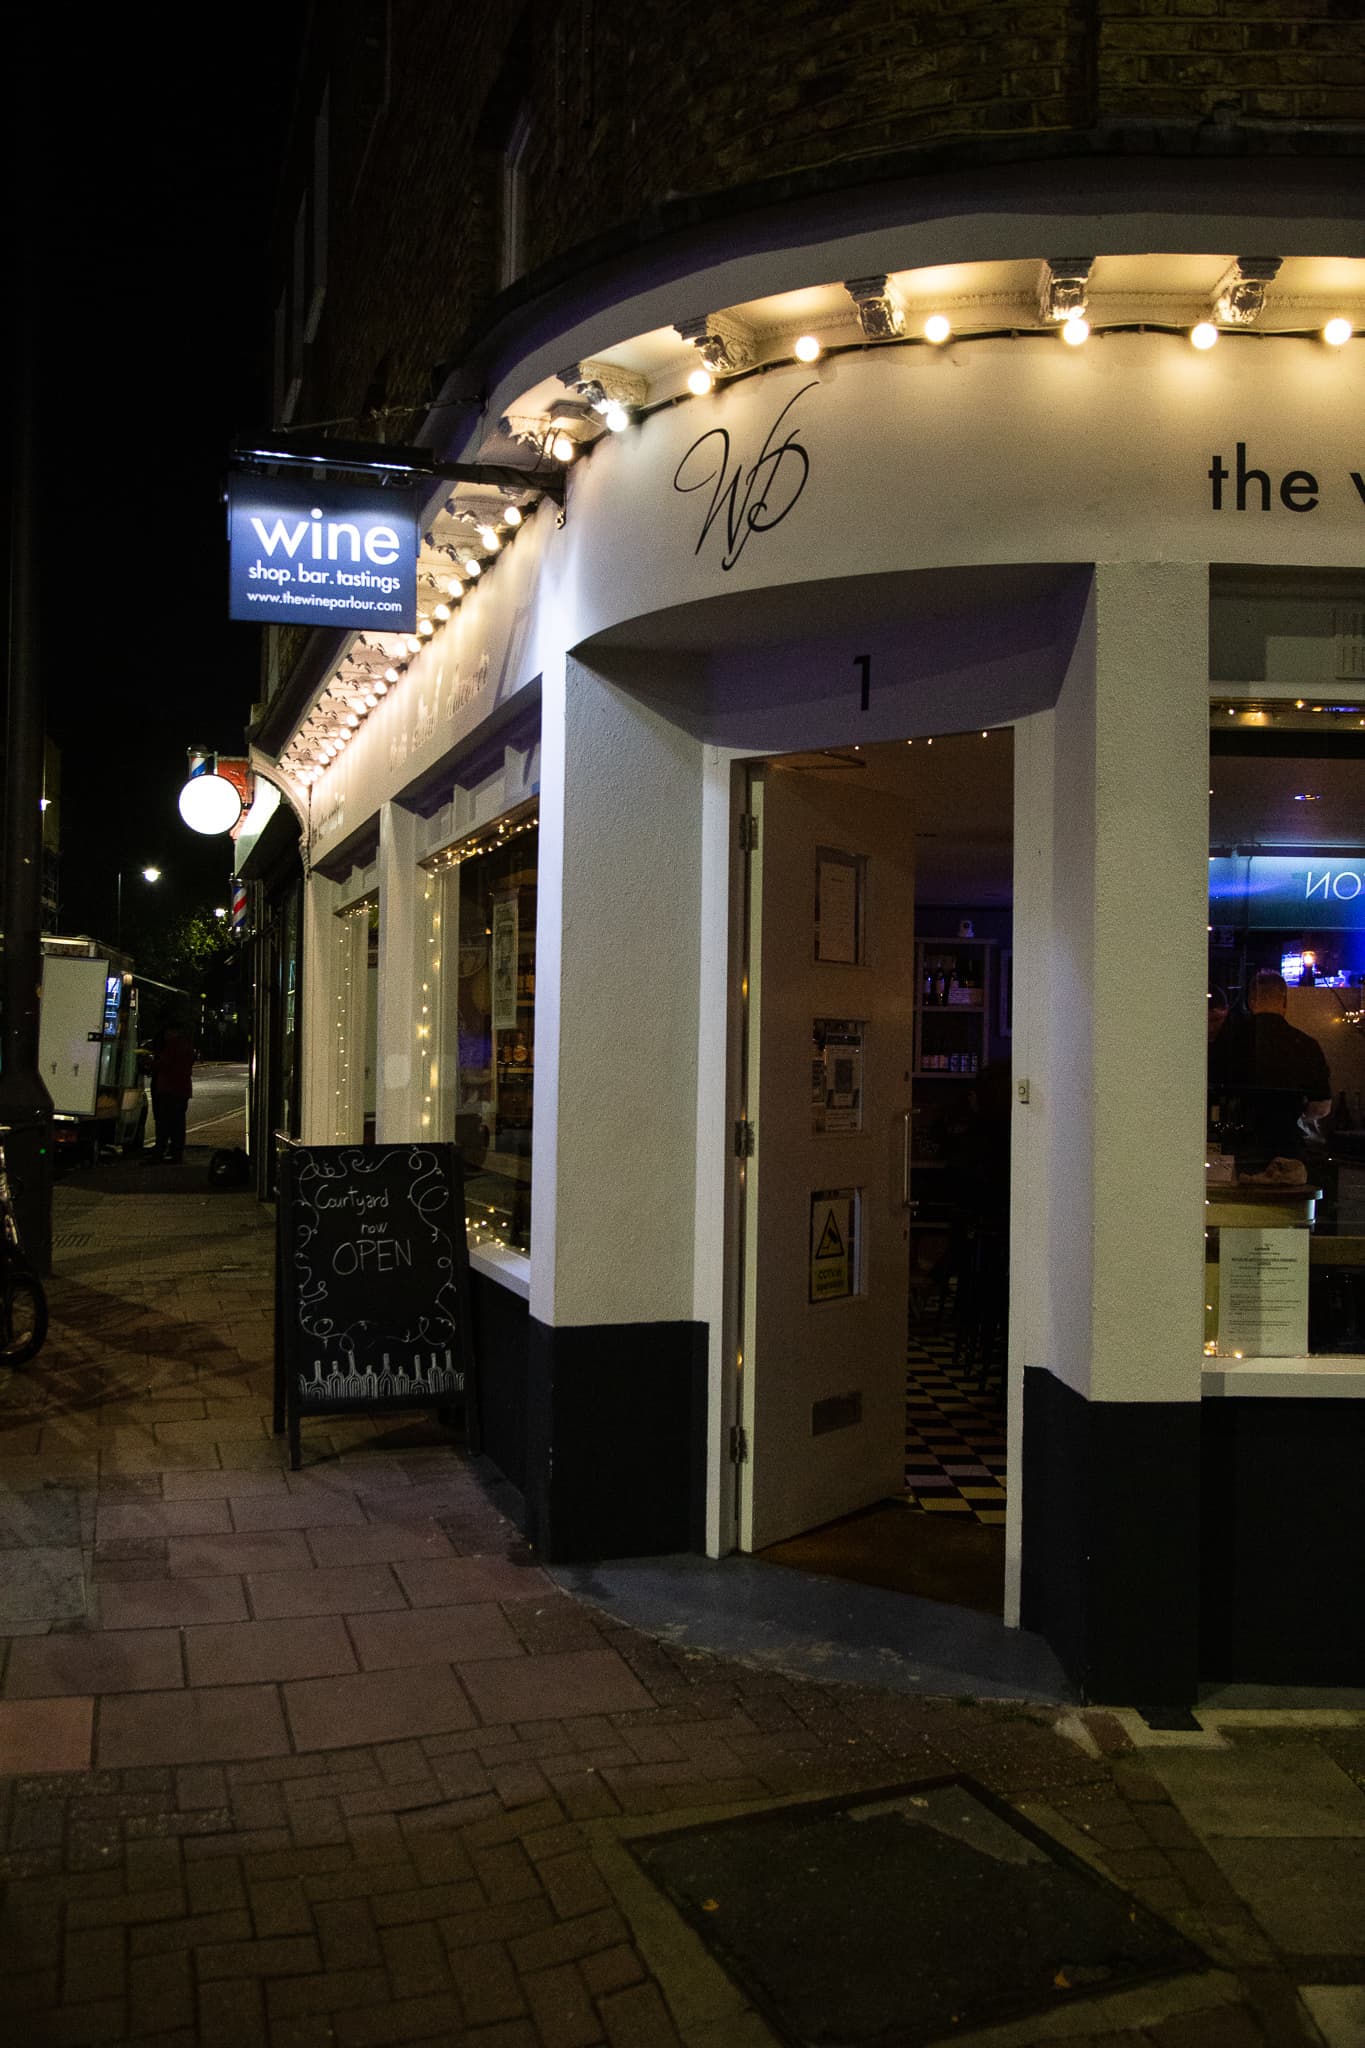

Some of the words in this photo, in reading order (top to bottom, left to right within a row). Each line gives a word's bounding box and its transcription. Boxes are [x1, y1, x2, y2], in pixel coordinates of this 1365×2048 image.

[1208, 442, 1319, 512] the
[250, 507, 401, 565] wine
[336, 569, 401, 594] tastings
[246, 590, 403, 612] www.thewineparlour.com
[853, 655, 870, 710] 1
[314, 1184, 389, 1216] Courtyard
[360, 1222, 388, 1234] now
[332, 1239, 413, 1275] OPEN
